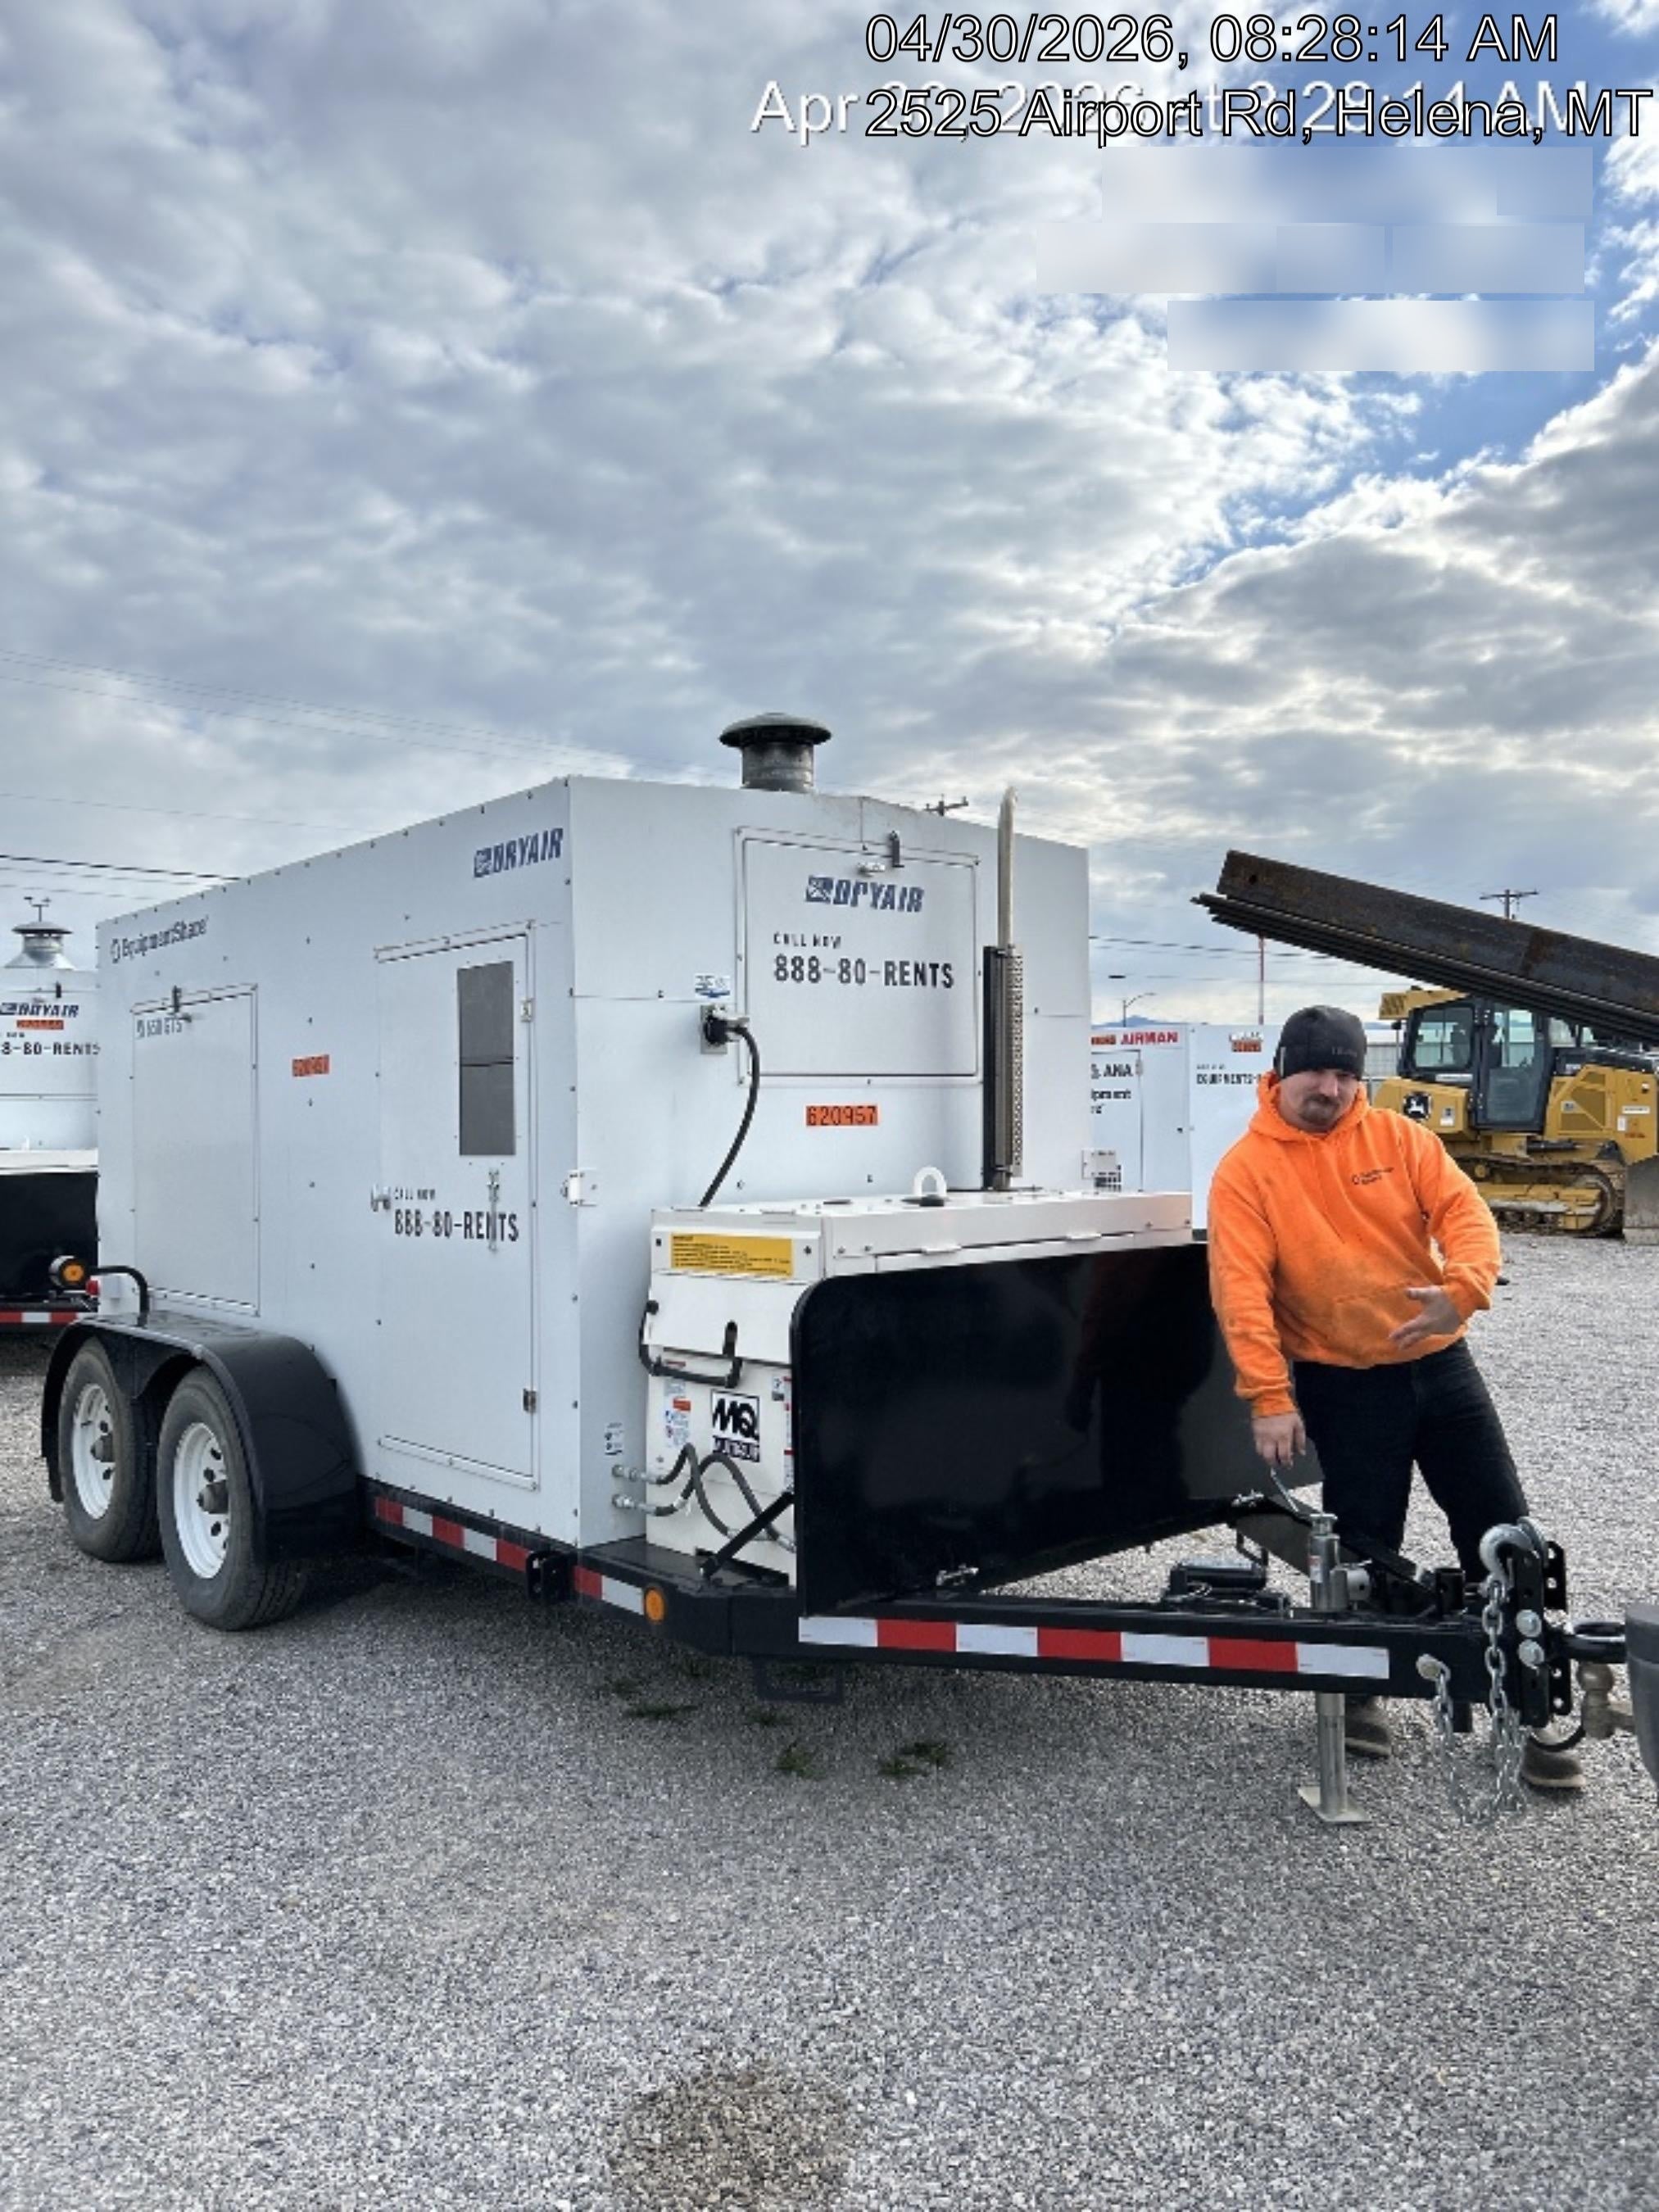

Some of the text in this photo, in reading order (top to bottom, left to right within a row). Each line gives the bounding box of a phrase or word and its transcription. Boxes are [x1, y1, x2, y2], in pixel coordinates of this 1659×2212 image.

[492, 827, 563, 873] DRYAIR
[833, 879, 925, 913] DRYAIR
[774, 954, 954, 990] 888-80-RENTS
[1120, 1031, 1178, 1045] AIRMAN
[806, 1104, 878, 1126] 620957
[394, 1208, 519, 1242] 888-80-RENTS
